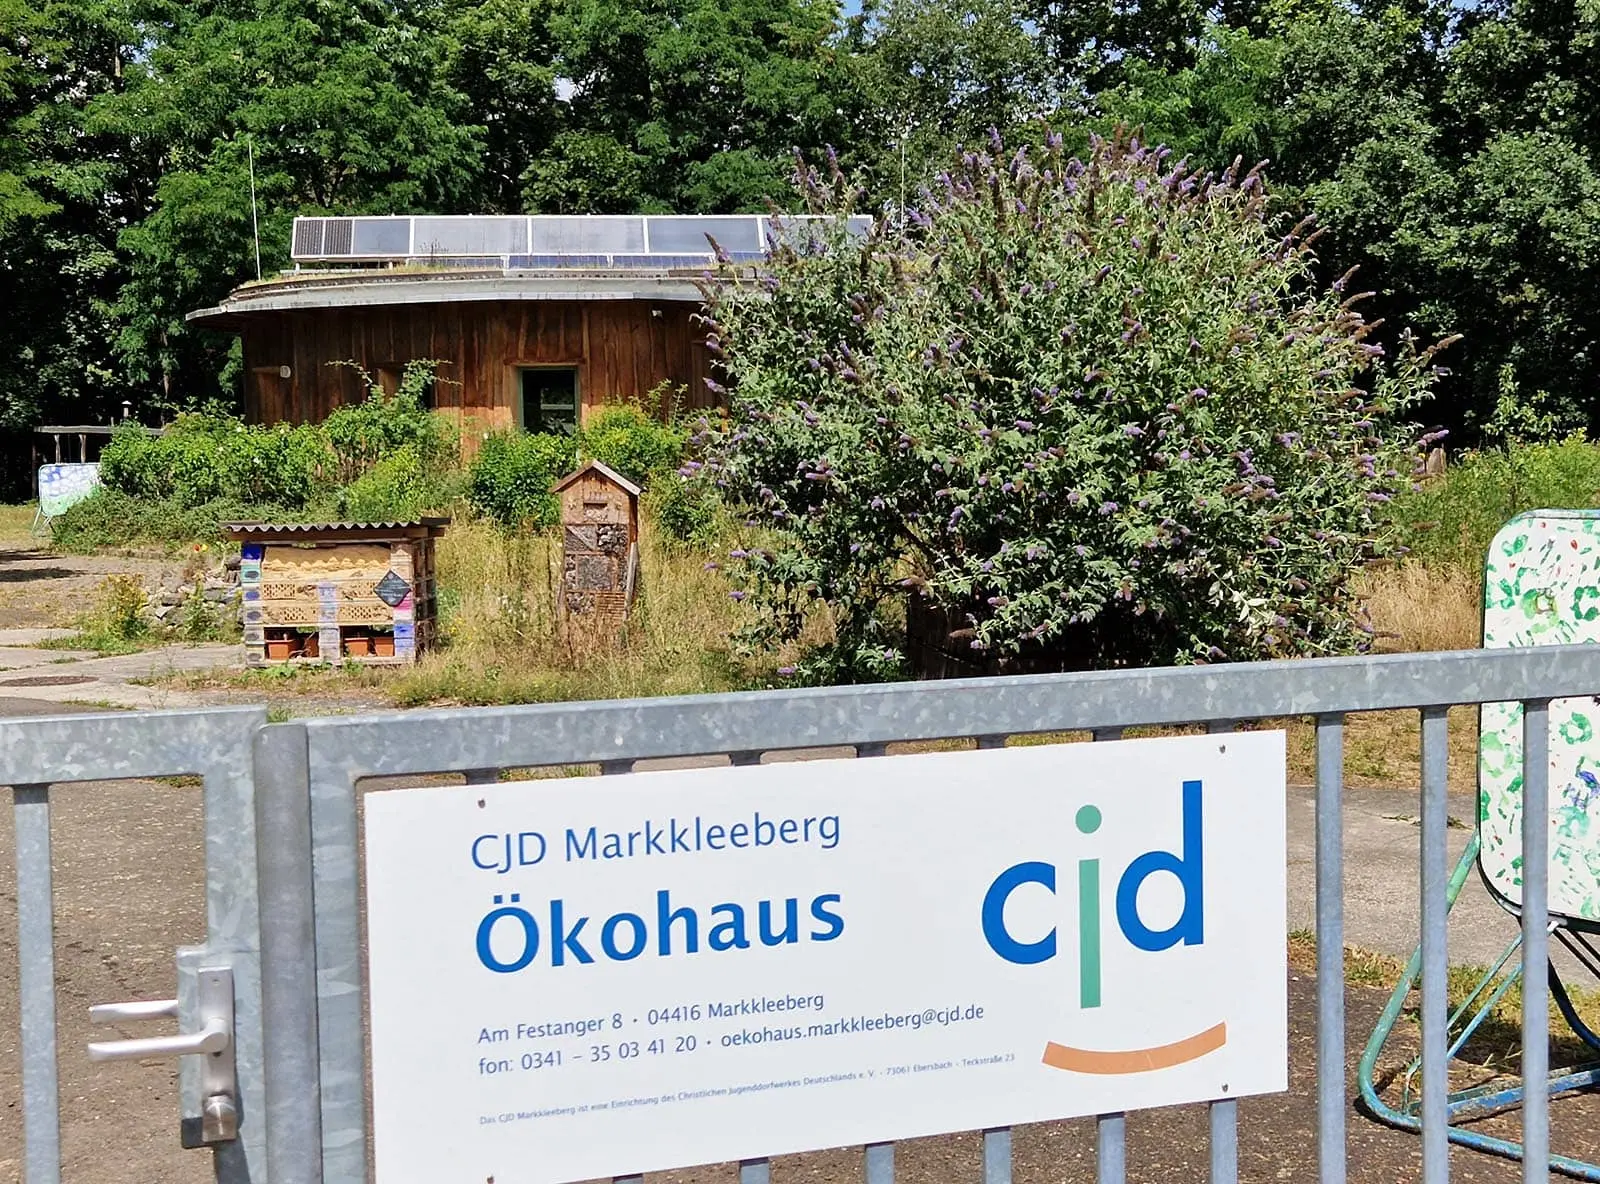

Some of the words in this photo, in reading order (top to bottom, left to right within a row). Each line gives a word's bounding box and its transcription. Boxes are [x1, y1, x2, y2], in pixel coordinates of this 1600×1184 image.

[471, 831, 547, 875] CJD
[565, 811, 841, 862] Markkleeberg
[475, 889, 845, 974] Ökohaus
[478, 1027, 510, 1045] Am
[516, 1017, 606, 1041] Festanger
[611, 1012, 624, 1030] 8
[647, 1003, 702, 1026] 04416
[707, 992, 825, 1019] Markkleeberg
[478, 1056, 514, 1075] fon:
[520, 1049, 563, 1071] 0341
[590, 1044, 612, 1063] 35
[617, 1041, 641, 1060] 03
[646, 1038, 666, 1056] 41
[674, 1034, 697, 1053] 20
[720, 1003, 985, 1048] oekohaus.markkleeberg@cjd.de
[479, 1115, 497, 1125] Das
[498, 1112, 515, 1124] CJD
[517, 1105, 576, 1120] Markkleeberg
[661, 1094, 676, 1103] des
